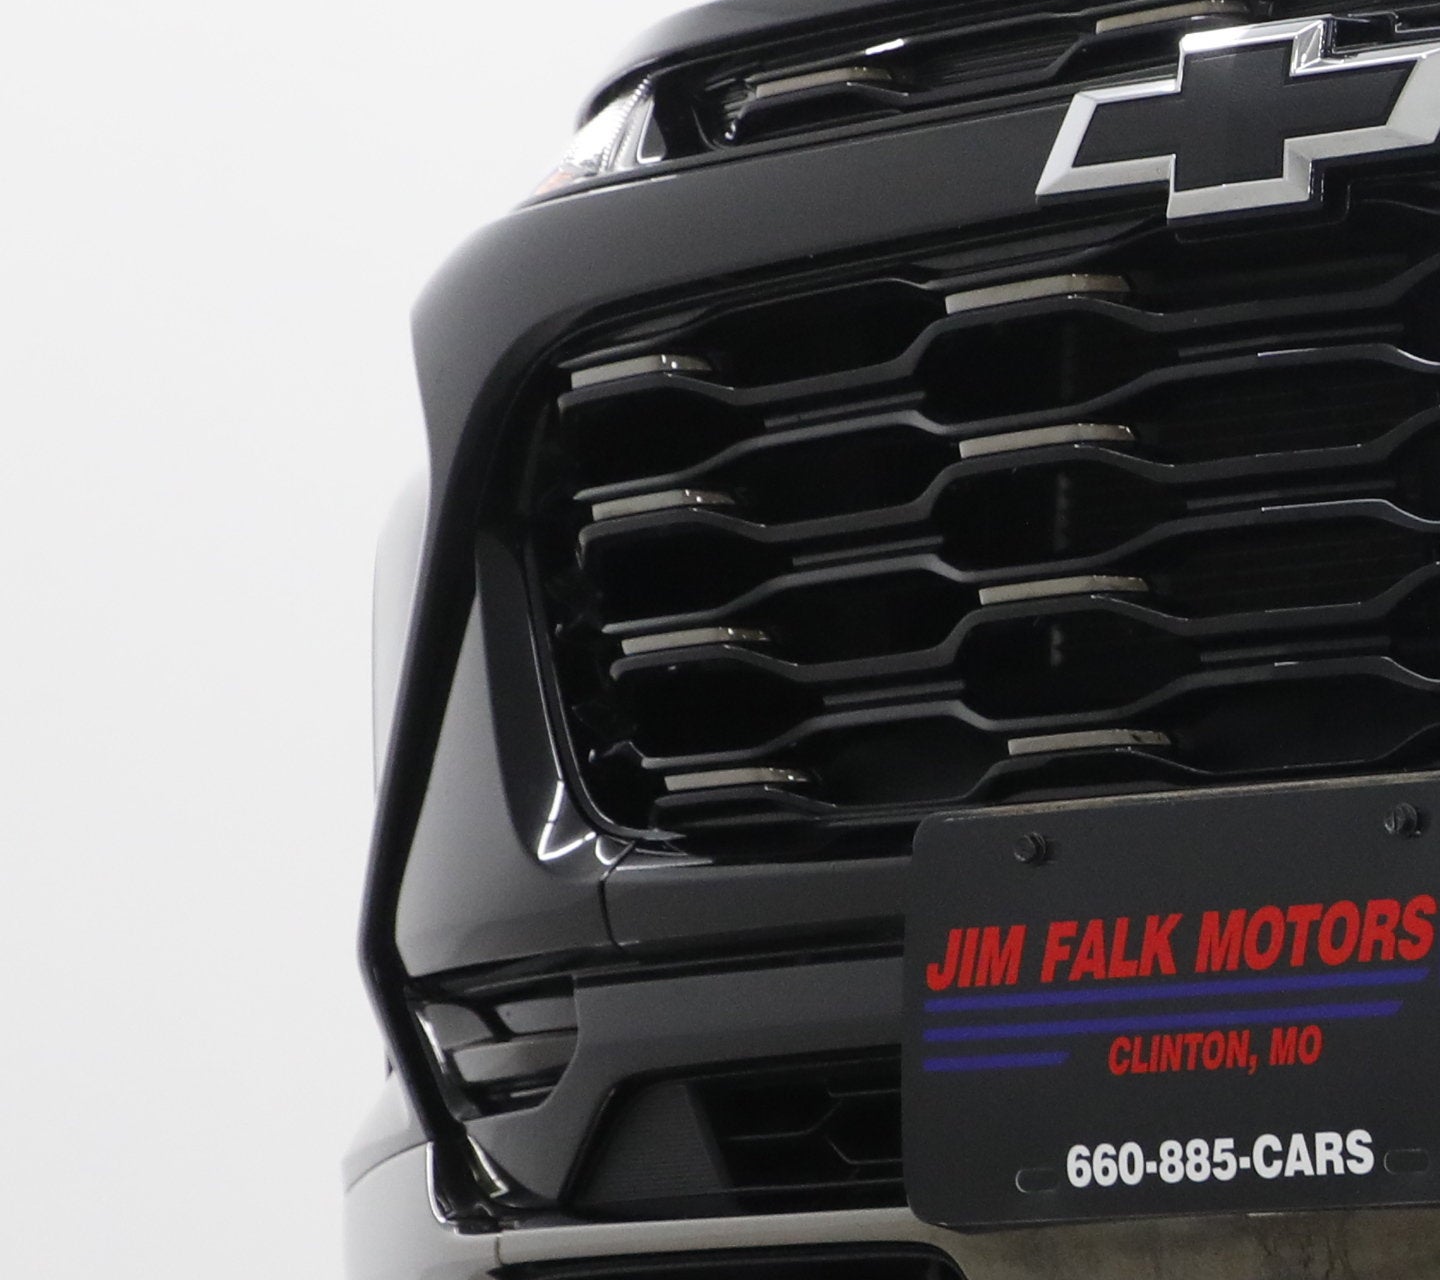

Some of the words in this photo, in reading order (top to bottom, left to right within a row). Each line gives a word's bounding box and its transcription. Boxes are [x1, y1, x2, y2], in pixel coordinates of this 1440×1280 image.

[925, 924, 1028, 992] JIM
[1039, 912, 1184, 983] FALK
[1194, 893, 1438, 974] MOTORS
[1107, 1028, 1259, 1076] CLINTON,
[1268, 1024, 1324, 1066] MO
[1066, 1128, 1376, 1188] 660-885-CARS
